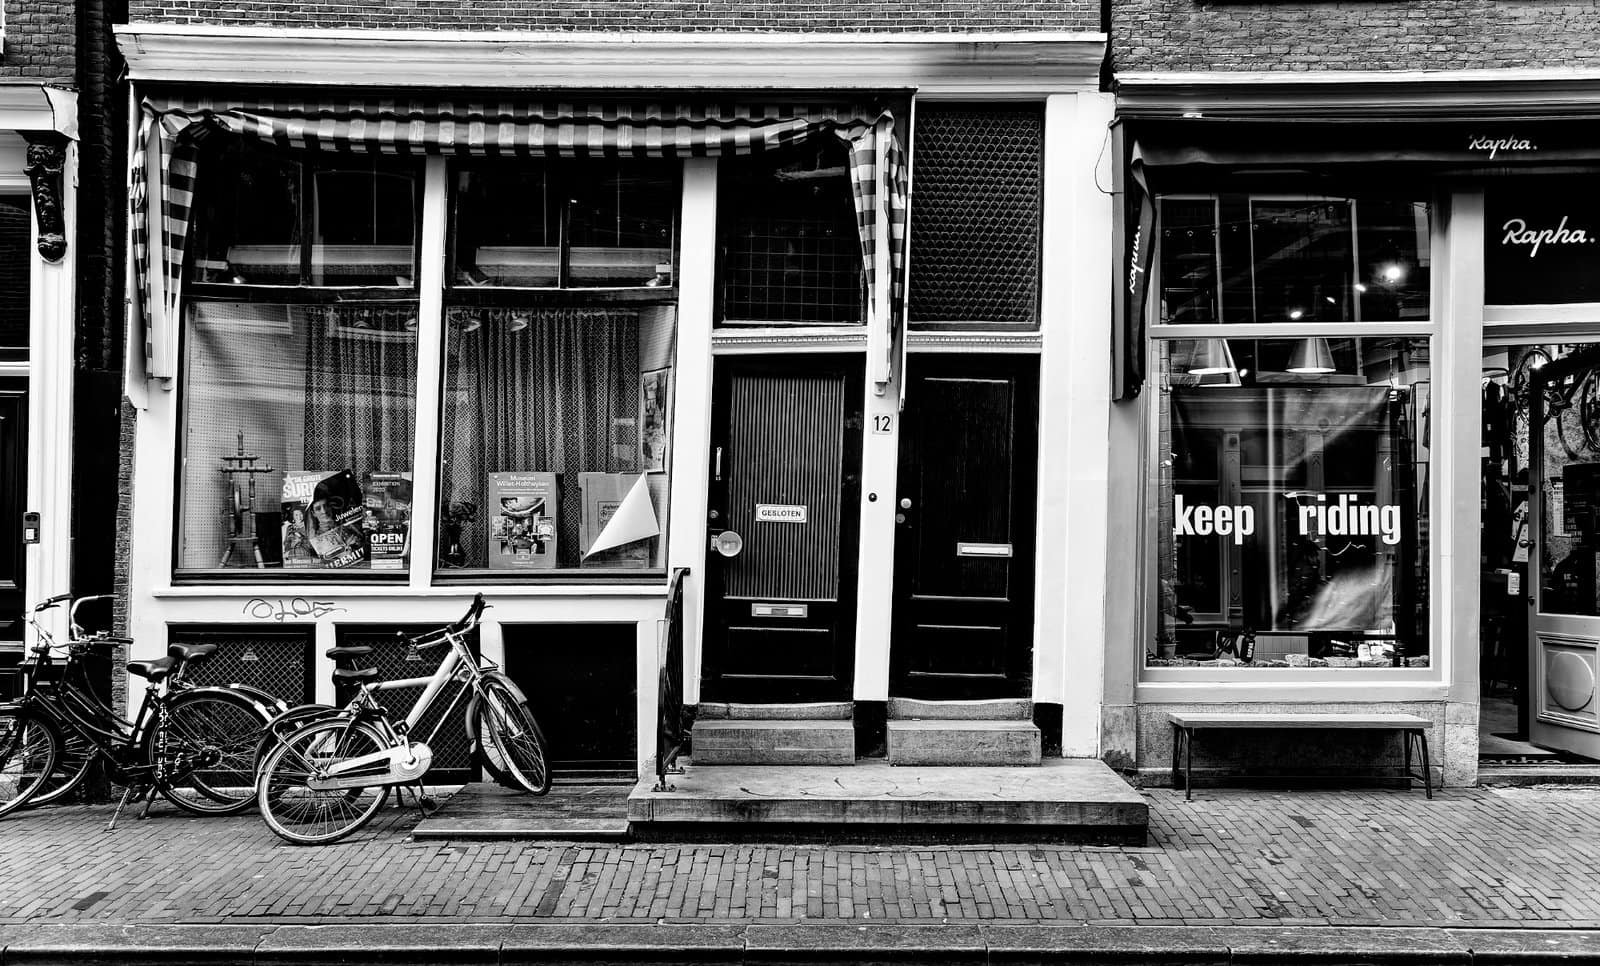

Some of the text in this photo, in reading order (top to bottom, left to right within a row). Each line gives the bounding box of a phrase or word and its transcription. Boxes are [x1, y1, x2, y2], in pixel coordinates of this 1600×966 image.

[1501, 215, 1596, 258] Rapha.
[873, 415, 891, 432] 12
[761, 509, 801, 518] GESLOTEN
[1174, 494, 1401, 546] keep riding
[370, 533, 404, 544] OPEN
